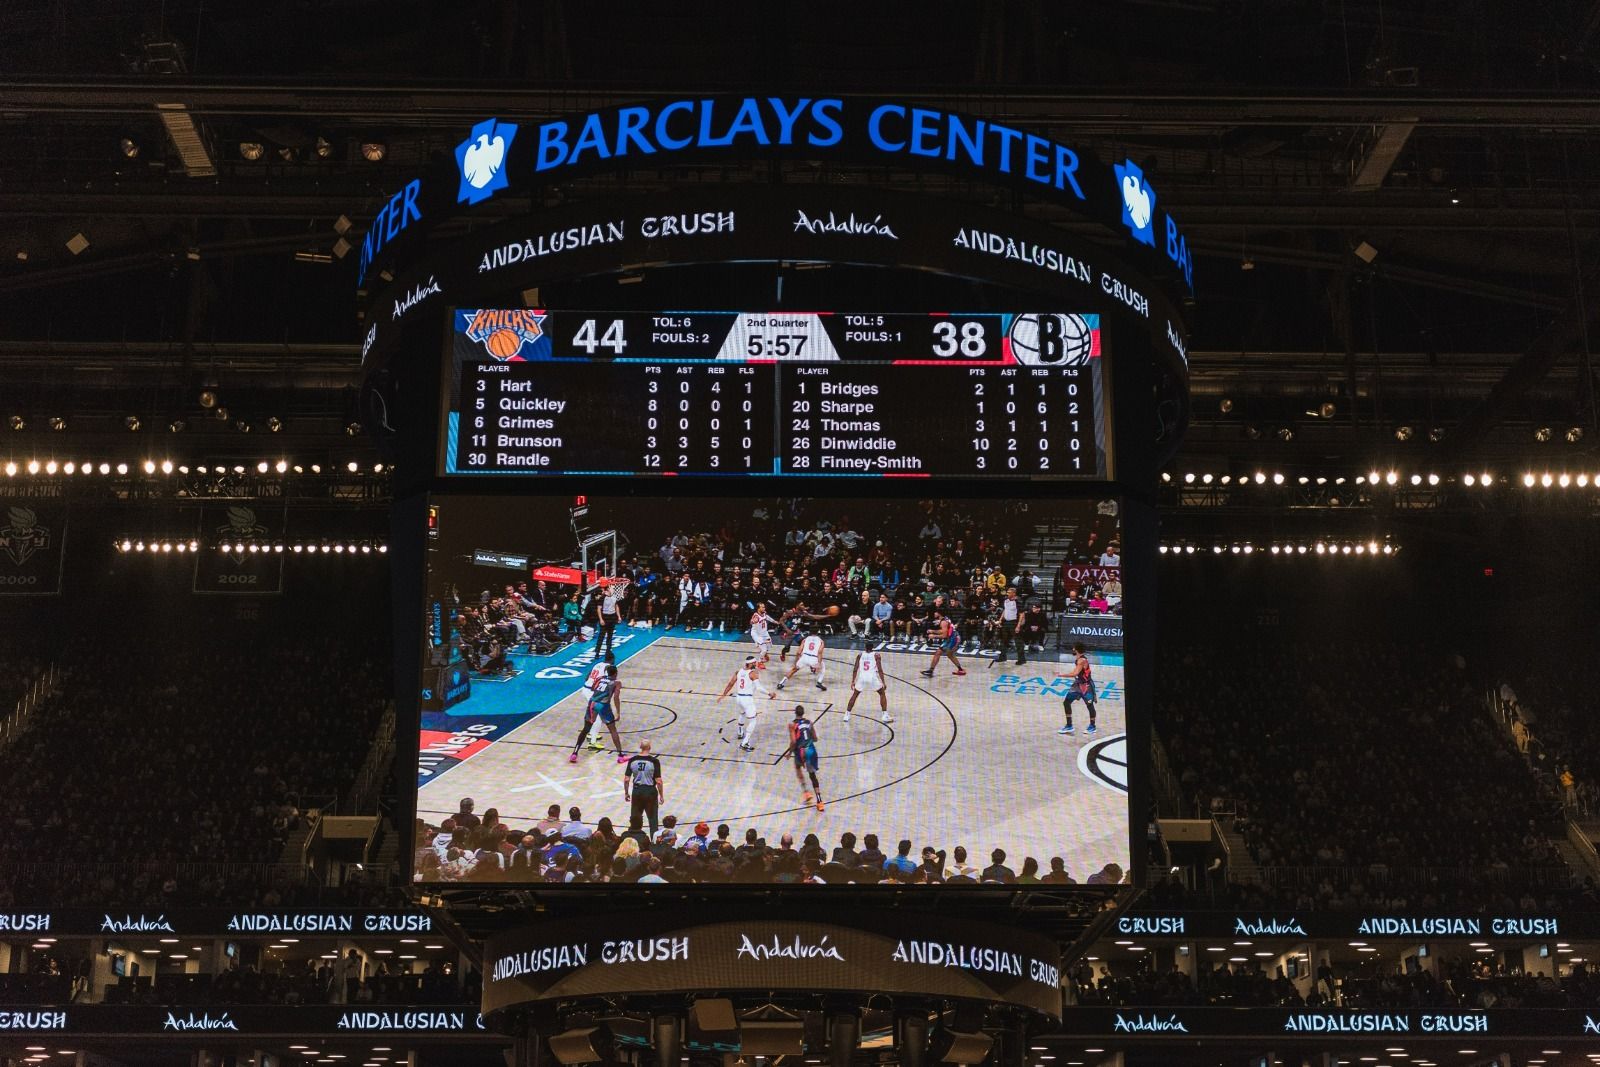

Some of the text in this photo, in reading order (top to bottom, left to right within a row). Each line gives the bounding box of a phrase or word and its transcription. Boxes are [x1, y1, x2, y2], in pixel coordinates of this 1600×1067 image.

[535, 97, 1085, 200] BARCLAYS CENTER
[478, 211, 735, 273] ANDALUSIAN CRUSH
[953, 228, 1149, 318] ANDALUSIAN CRUSH
[467, 309, 541, 337] KNICKS
[652, 317, 692, 328] TOL: 6
[746, 316, 809, 329] 2nd Quarter
[844, 315, 884, 326] TOL: 5
[572, 319, 628, 354] 44
[652, 332, 710, 344] FOULS: 2
[845, 331, 901, 342] FOULS: 1
[932, 321, 987, 358] 38
[1037, 314, 1066, 363] B
[746, 334, 809, 357] 5:57
[477, 364, 755, 375] PLAYER PTS AST REB FLS
[797, 367, 1079, 377] PLAYER PTS AST REB FLS
[476, 379, 752, 394] 3 Hart 3 0 4 1
[798, 382, 1078, 397] 1 Bridges 2 1 1 0
[475, 397, 752, 414] 5 Quickley 8 0 0 0
[792, 400, 1079, 415] 20 Sharpe 1 0 6 2
[474, 415, 751, 431] 6 Grimes 0 0 0 1
[792, 418, 1079, 433] 24 Thomas 3 1 1 1
[471, 434, 752, 449] 11 Brunson 3 3 5 0
[792, 436, 1080, 451] 26 Dinwiddie 10 2 0 0
[468, 452, 751, 468] 30 Randle 12 2 3 1
[792, 455, 1080, 470] 28 Finney-Smith 3 0 2 1
[217, 574, 258, 585] 2002
[862, 660, 870, 671] 5
[739, 678, 746, 689] 3
[995, 674, 1125, 691] BARL
[637, 762, 647, 771] 37
[0, 914, 50, 931] RUSH
[227, 914, 431, 932] ANDALUSIAN CRUSH
[1118, 917, 1185, 934] CRUSH
[1358, 918, 1558, 935] ANDALUSIAN CRUSH
[492, 936, 689, 982] ANDALUSIAN CRUSH
[891, 940, 1023, 977] ANDALUSIAN
[337, 1012, 464, 1030] ANDALUSIAN
[1284, 1014, 1488, 1033] ANDALUSIAN CRUSH
